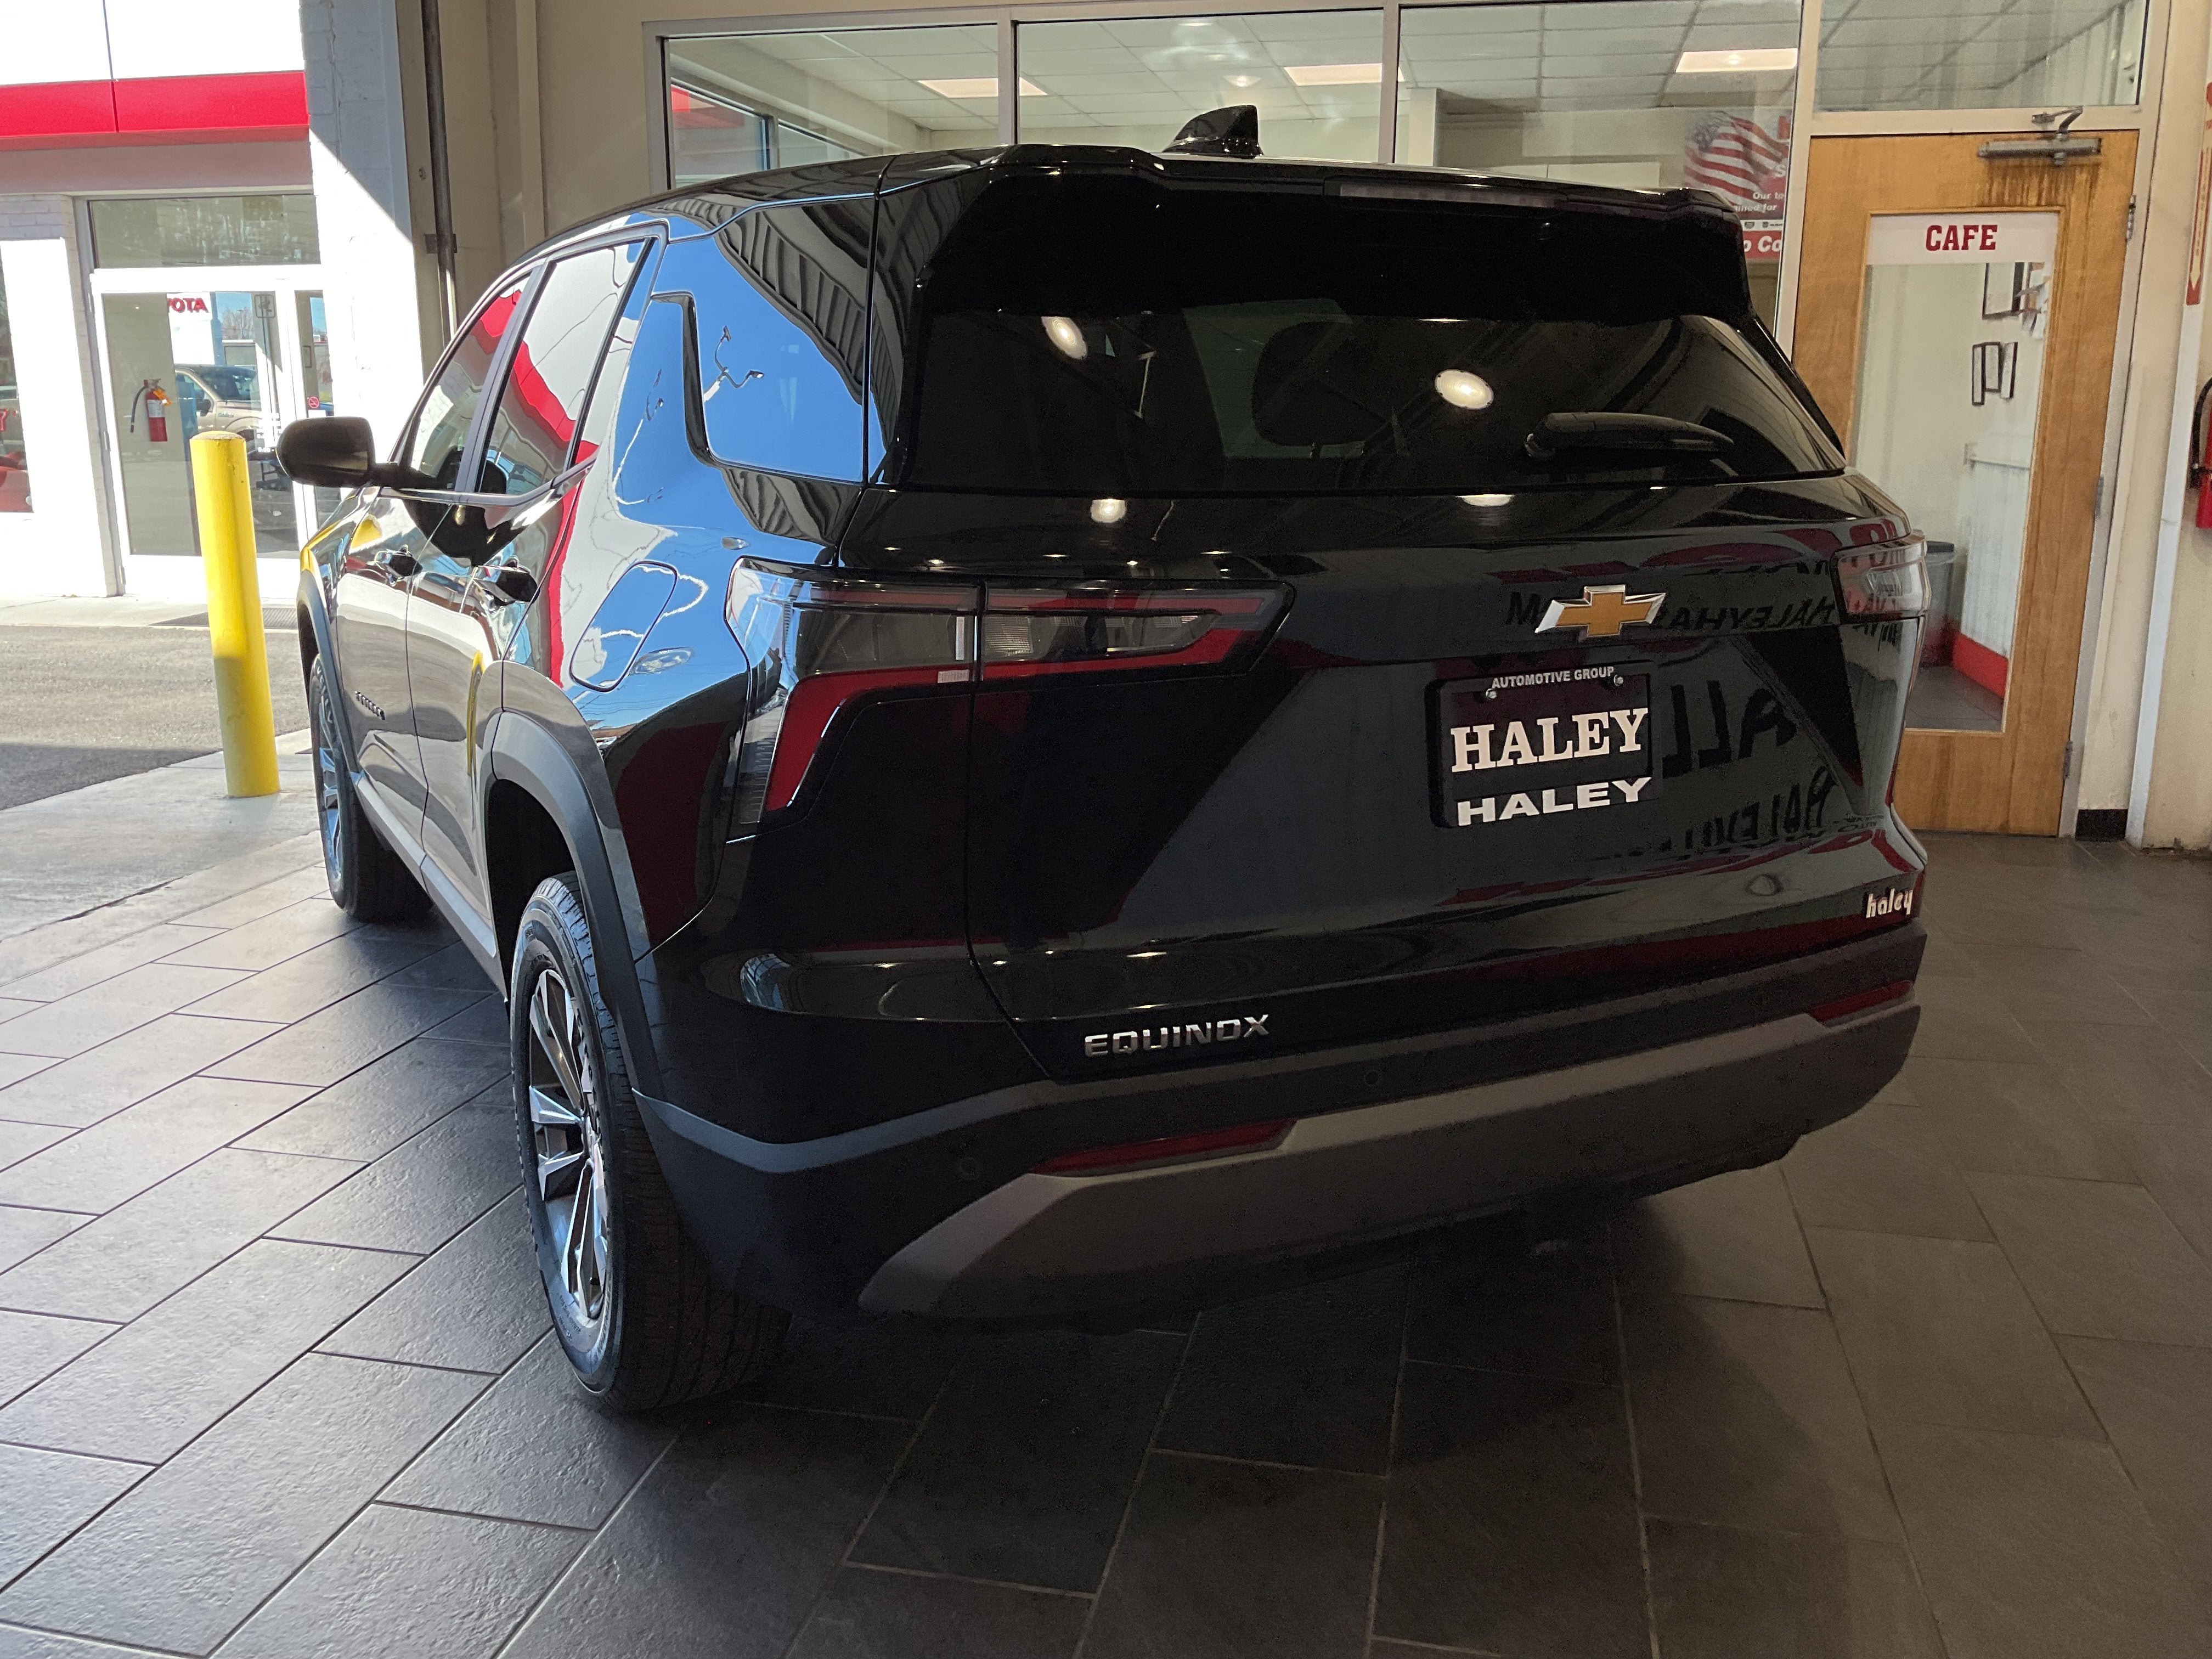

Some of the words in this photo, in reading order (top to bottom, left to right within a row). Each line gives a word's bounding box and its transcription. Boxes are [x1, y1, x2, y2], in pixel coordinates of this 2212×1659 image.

[1763, 204, 1777, 213] for
[1926, 224, 1997, 251] CAFE
[1492, 671, 1570, 689] AUTOMOTIVE
[1574, 666, 1615, 680] GROUP
[1451, 708, 1649, 772] HALEY
[1458, 777, 1652, 826] HALEY
[1865, 888, 1914, 919] haley
[1084, 1014, 1269, 1058] EQUINOX
